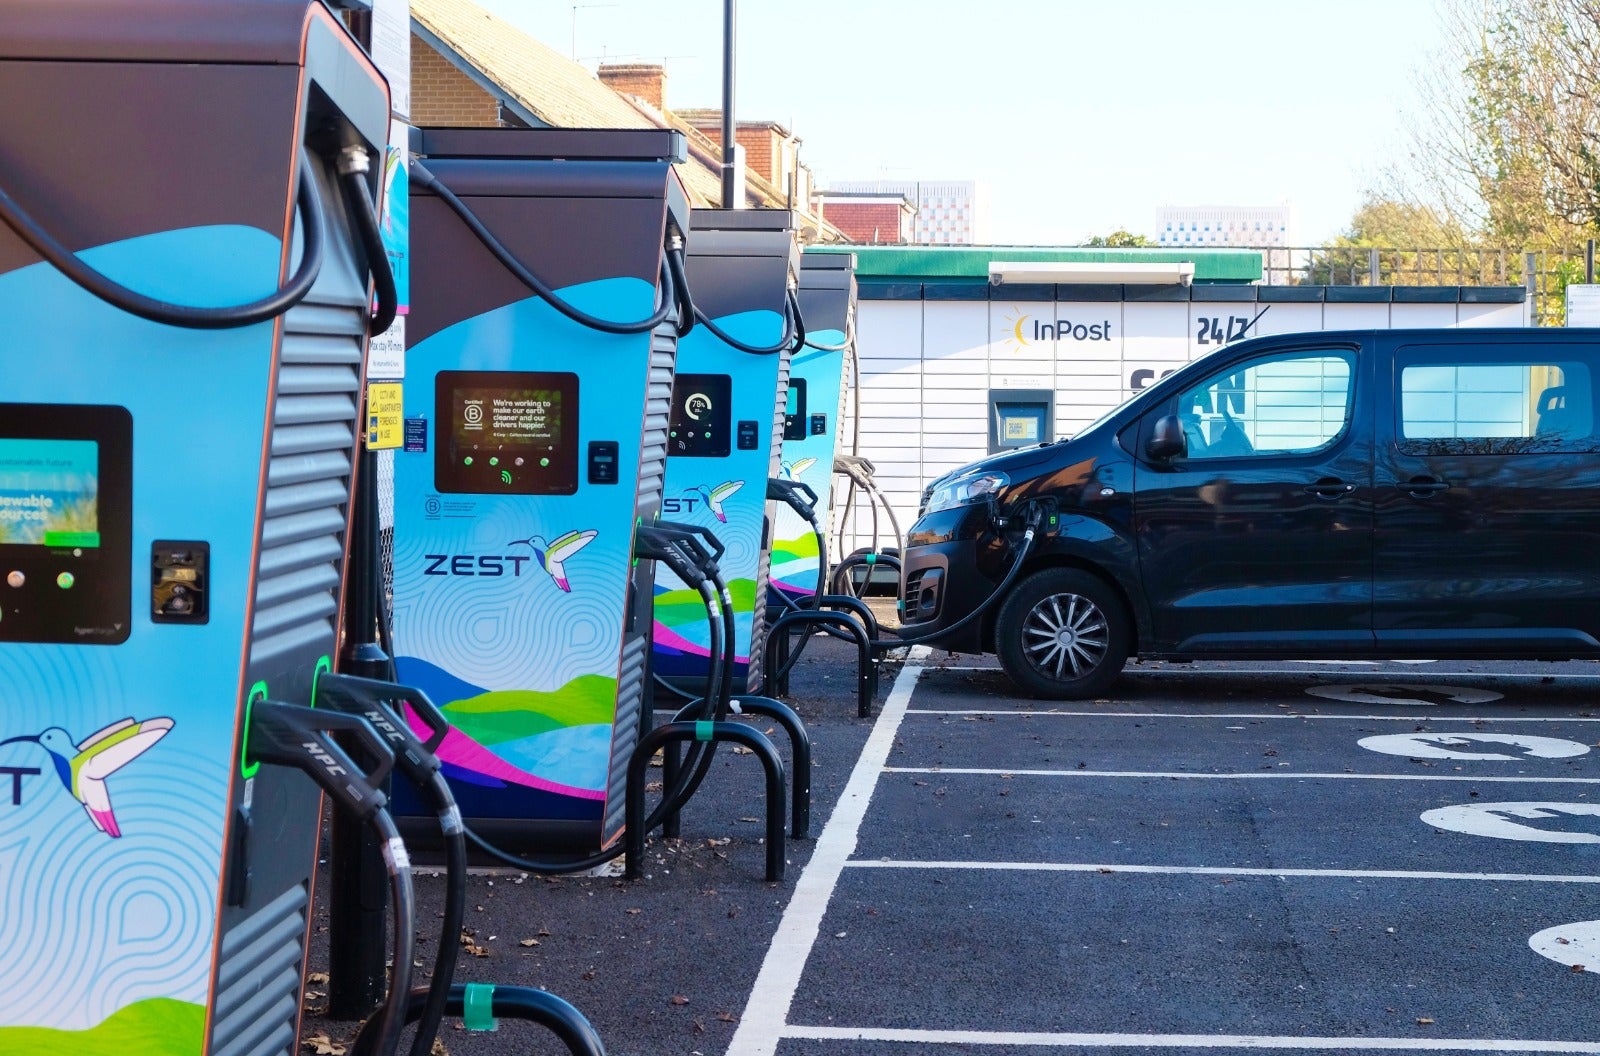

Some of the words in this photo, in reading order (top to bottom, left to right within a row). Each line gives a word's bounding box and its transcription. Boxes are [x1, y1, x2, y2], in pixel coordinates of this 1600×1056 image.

[1034, 320, 1111, 342] InPost
[1197, 315, 1248, 345] 24/7
[493, 399, 513, 407] We're
[514, 400, 542, 408] working
[518, 421, 546, 430] happier.
[0, 493, 53, 508] ewable
[424, 555, 530, 576] ZEST
[364, 710, 405, 743] HPC
[302, 742, 347, 776] HPC
